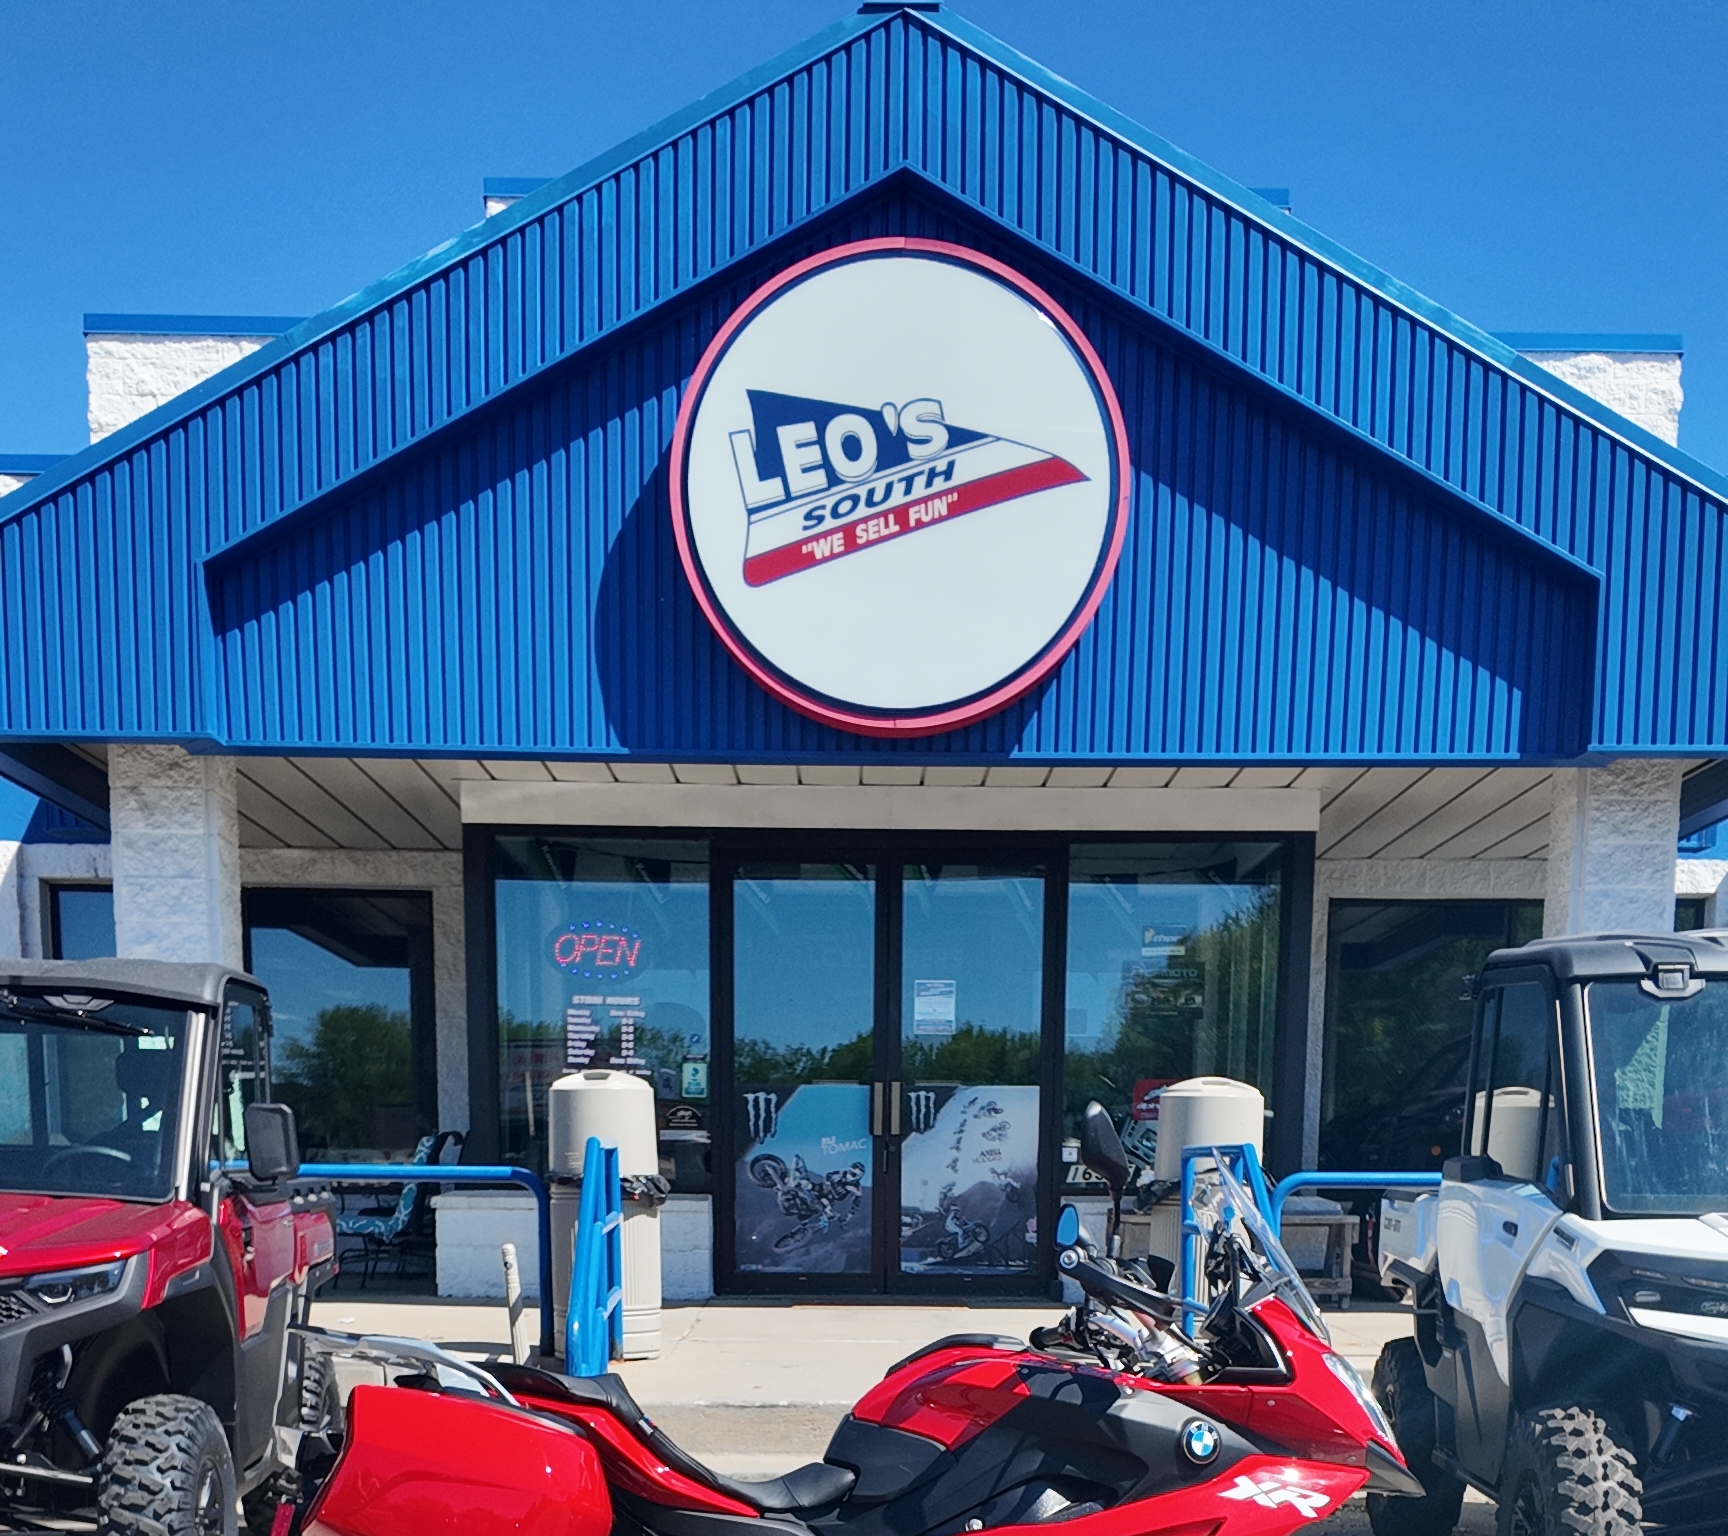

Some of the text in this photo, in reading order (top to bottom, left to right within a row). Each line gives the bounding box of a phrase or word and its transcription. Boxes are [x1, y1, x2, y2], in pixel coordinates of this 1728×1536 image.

[728, 397, 950, 511] LEO'S
[801, 458, 957, 531] SOUTH
[801, 492, 959, 559] "WE SELL FUN"
[554, 933, 641, 967] OPEN
[821, 1138, 868, 1156] TOMAC
[1216, 1475, 1331, 1519] XR
